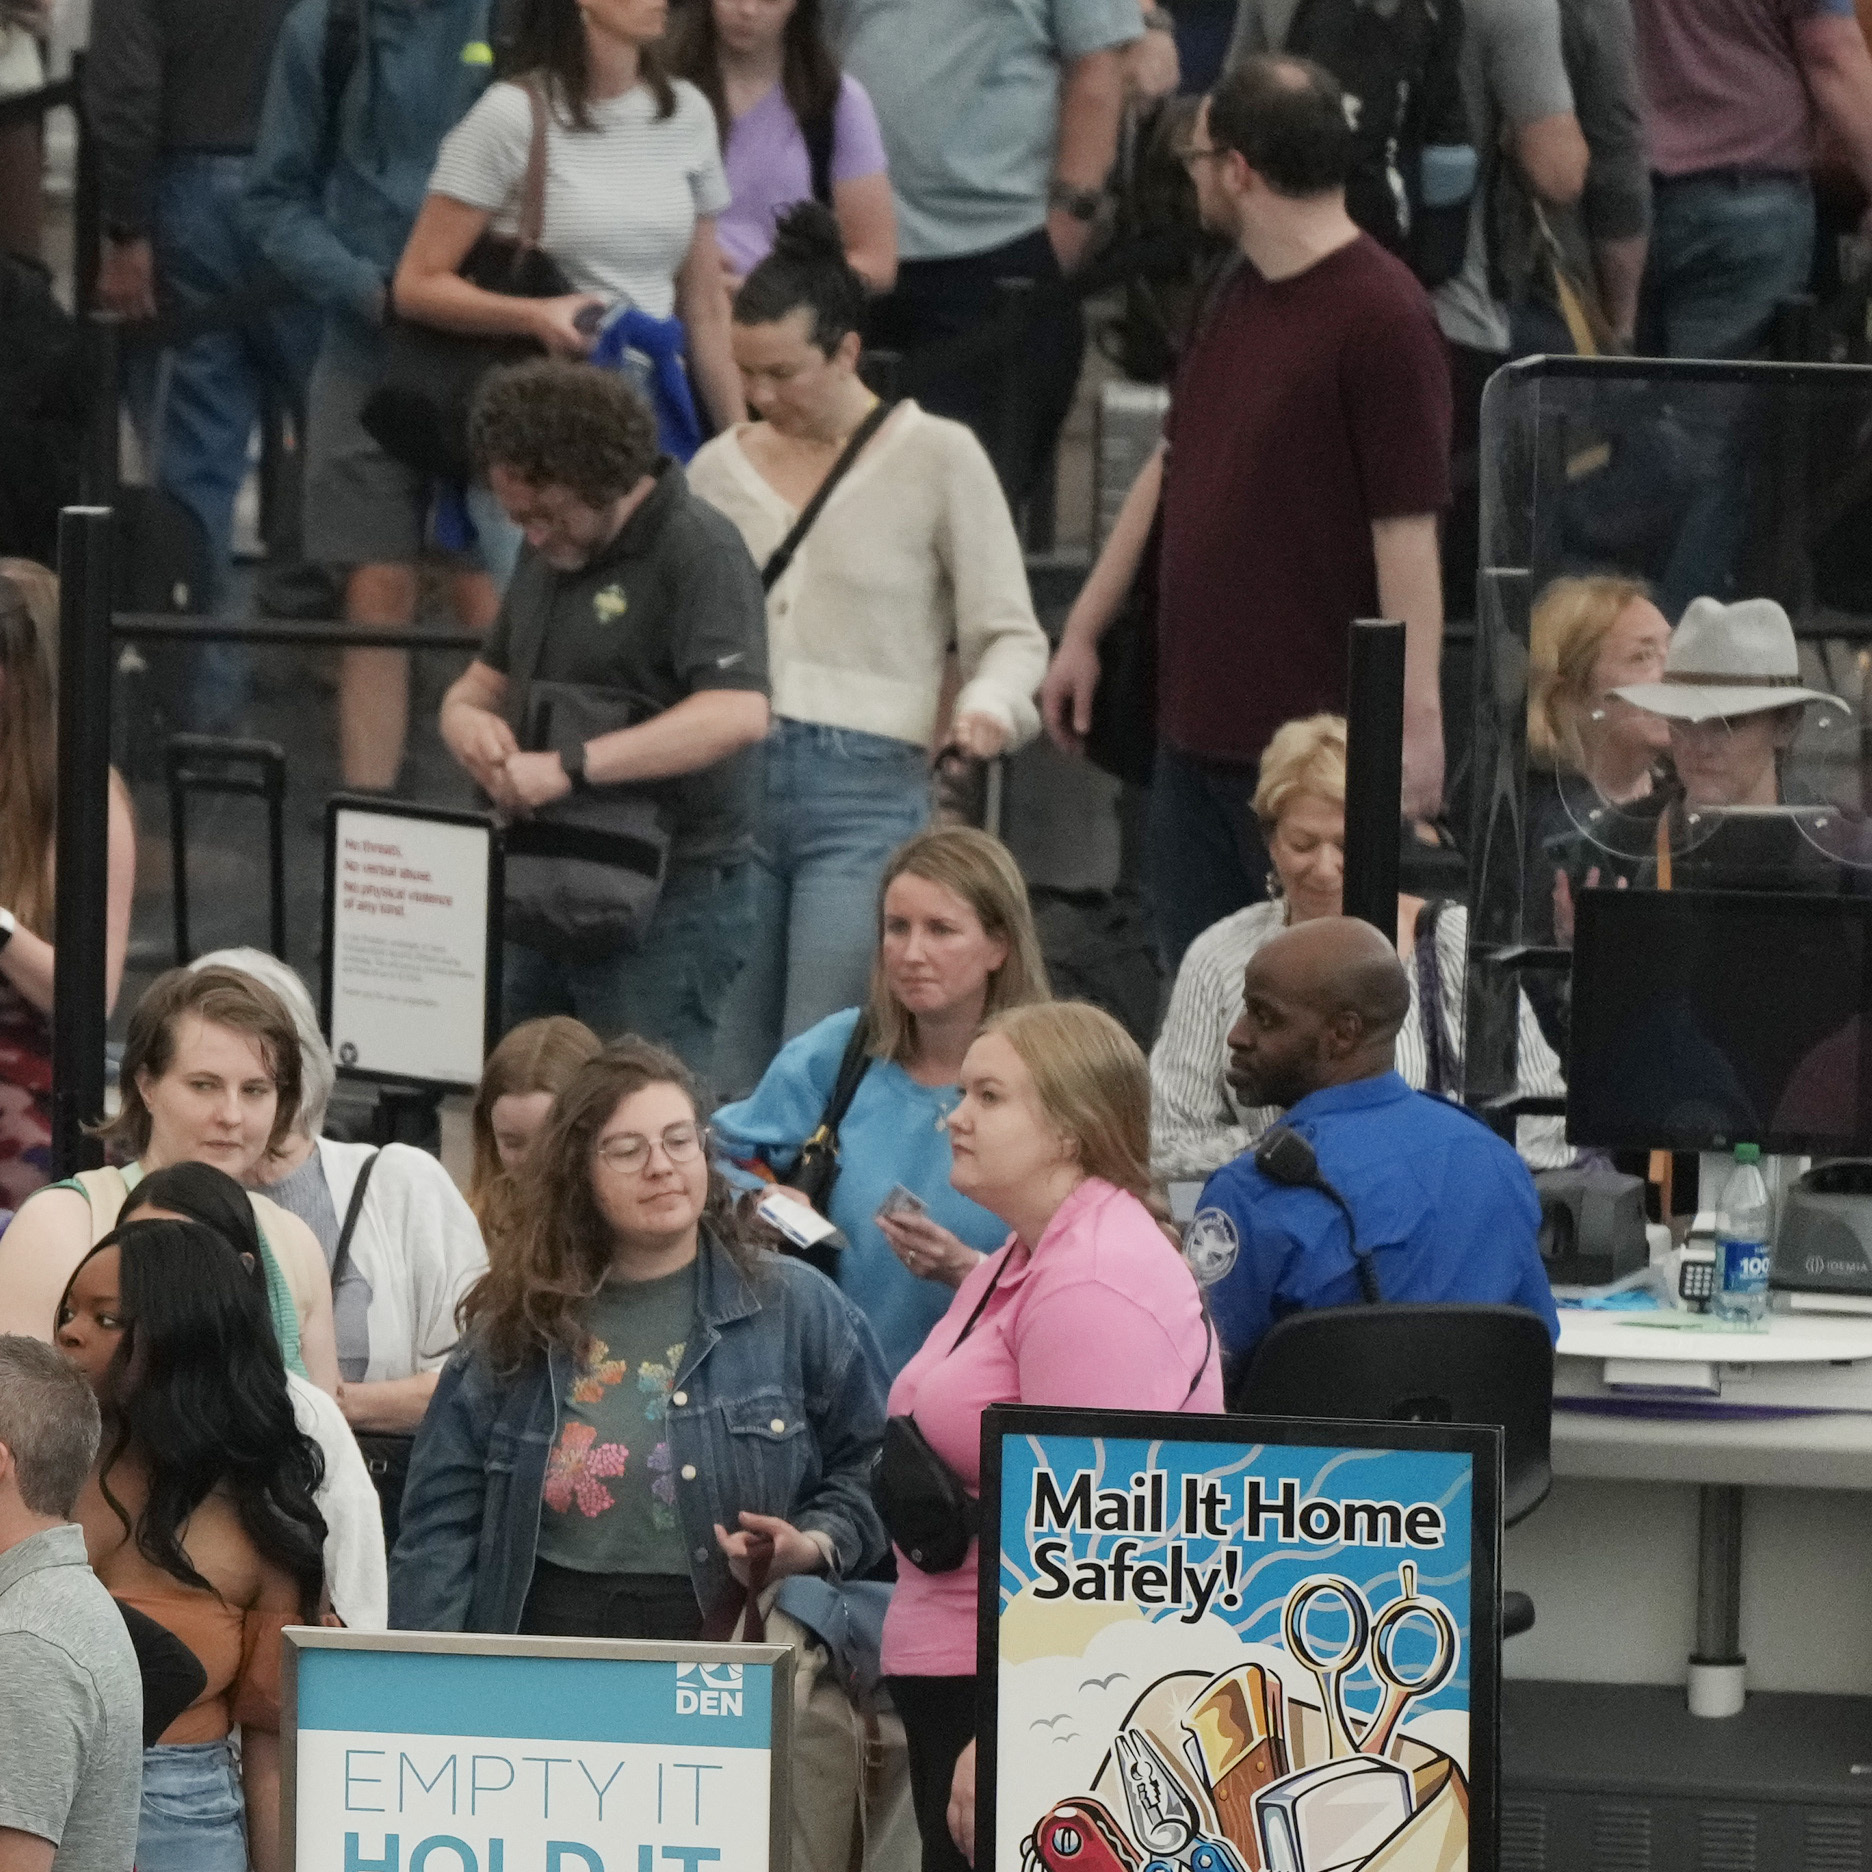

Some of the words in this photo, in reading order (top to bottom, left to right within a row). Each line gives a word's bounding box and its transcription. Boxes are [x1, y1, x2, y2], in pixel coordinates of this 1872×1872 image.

[1032, 1470, 1164, 1533] Mail
[1183, 1476, 1229, 1537] It
[1246, 1479, 1443, 1546] Home
[1032, 1541, 1241, 1625] Safely!
[676, 1688, 743, 1717] DEN
[344, 1749, 626, 1822] EMPTY
[657, 1762, 723, 1826] IT
